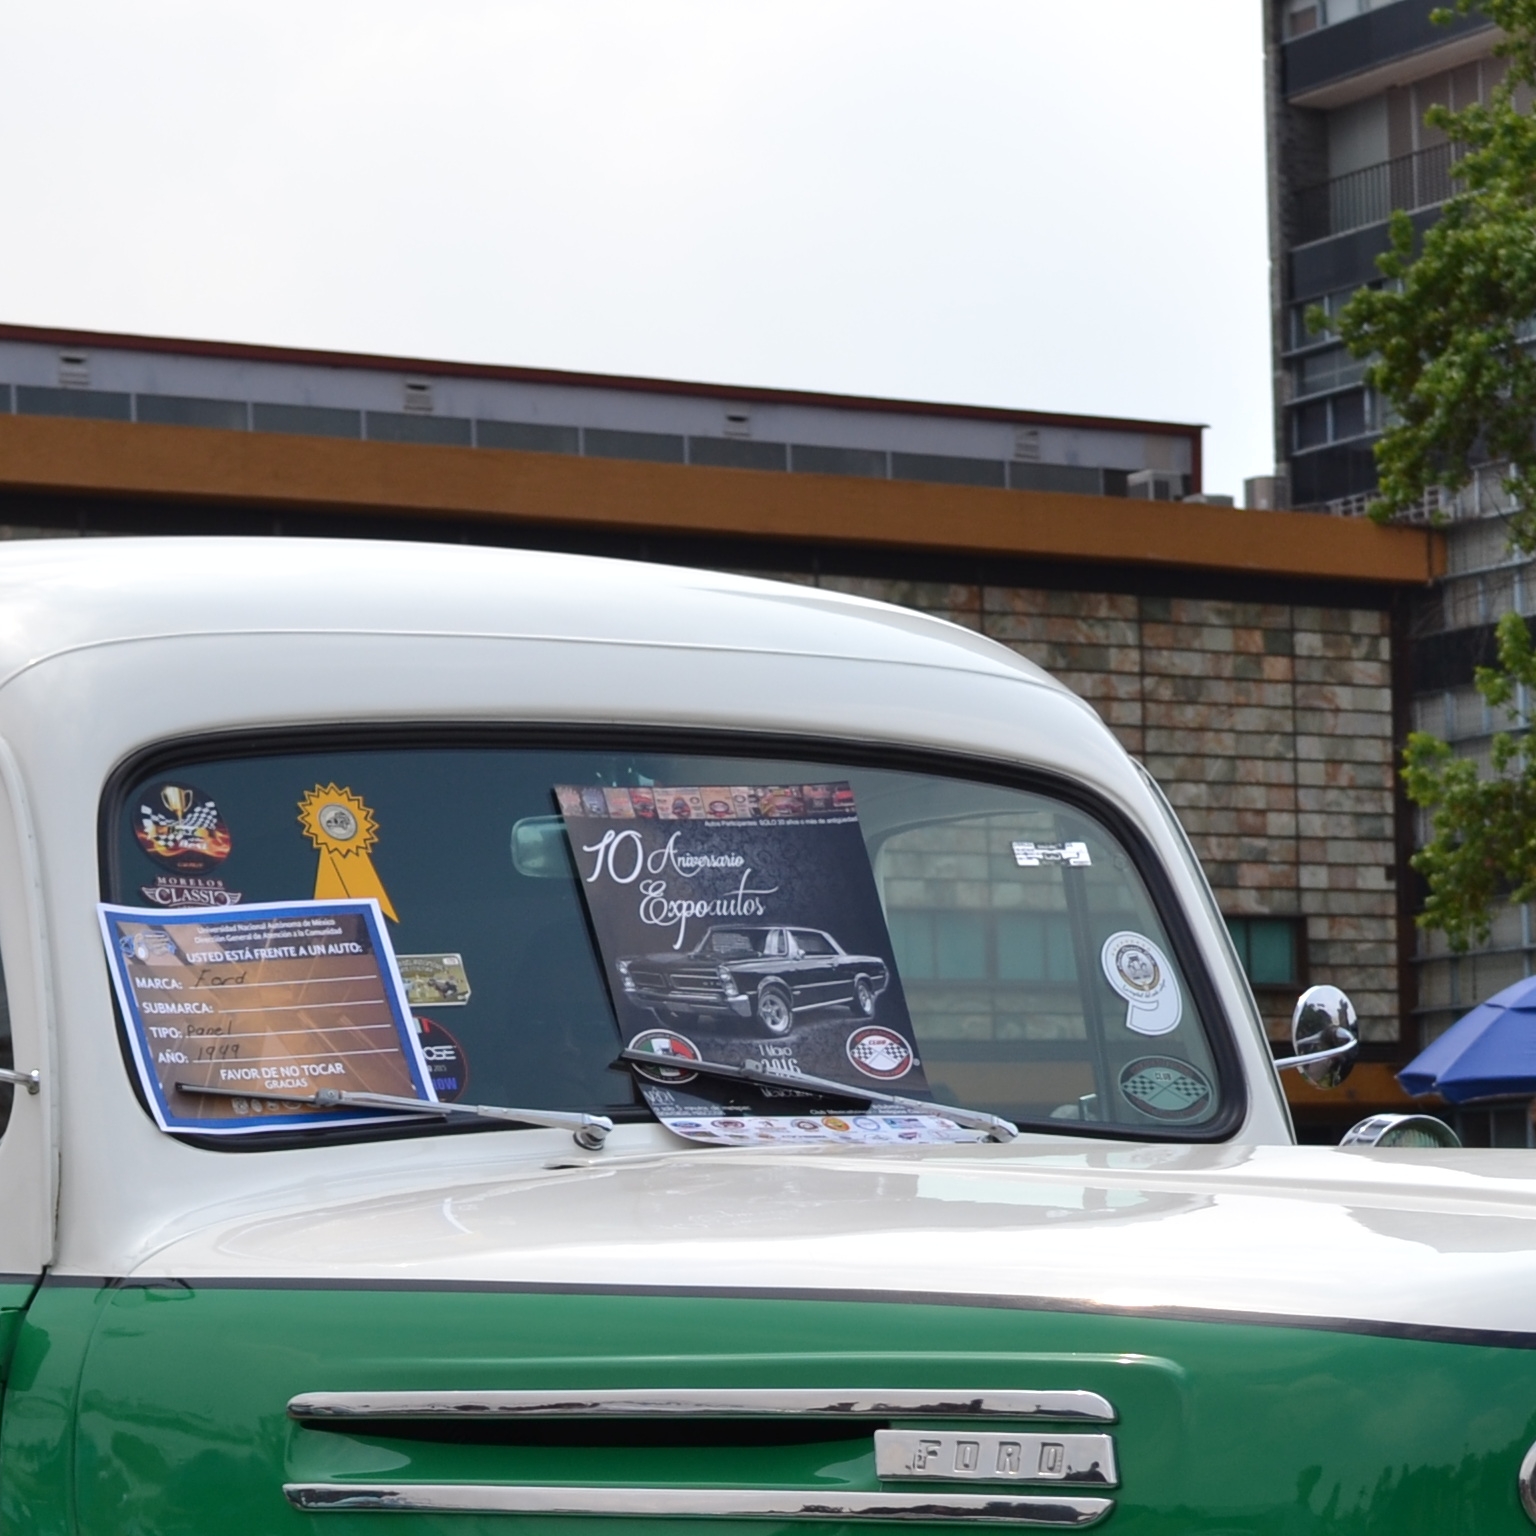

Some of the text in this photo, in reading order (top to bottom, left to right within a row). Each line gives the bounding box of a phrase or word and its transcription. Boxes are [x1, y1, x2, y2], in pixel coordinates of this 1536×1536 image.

[583, 830, 745, 884] 10 Aniversario
[156, 876, 224, 888] MORELOS
[639, 868, 779, 950] Expoautos
[197, 924, 238, 934] Universidad
[238, 922, 266, 933] Nacional
[302, 919, 311, 927] de
[226, 932, 253, 942] General
[253, 931, 263, 940] de
[305, 927, 342, 937] Comunidad
[186, 942, 364, 963] USTED ESTÁ FRENTE A UN AUTO:
[135, 977, 184, 990] MARCA:
[195, 969, 247, 988] Ford
[142, 1001, 214, 1014] SUBMARCA:
[149, 1026, 183, 1039] TIPO:
[158, 1049, 189, 1064] AÑO:
[197, 1044, 240, 1061] 1949
[220, 1062, 346, 1081] FAVOR DE NO TOCAR
[264, 1078, 308, 1089] GRACIAS
[914, 1439, 1066, 1476] FORD
